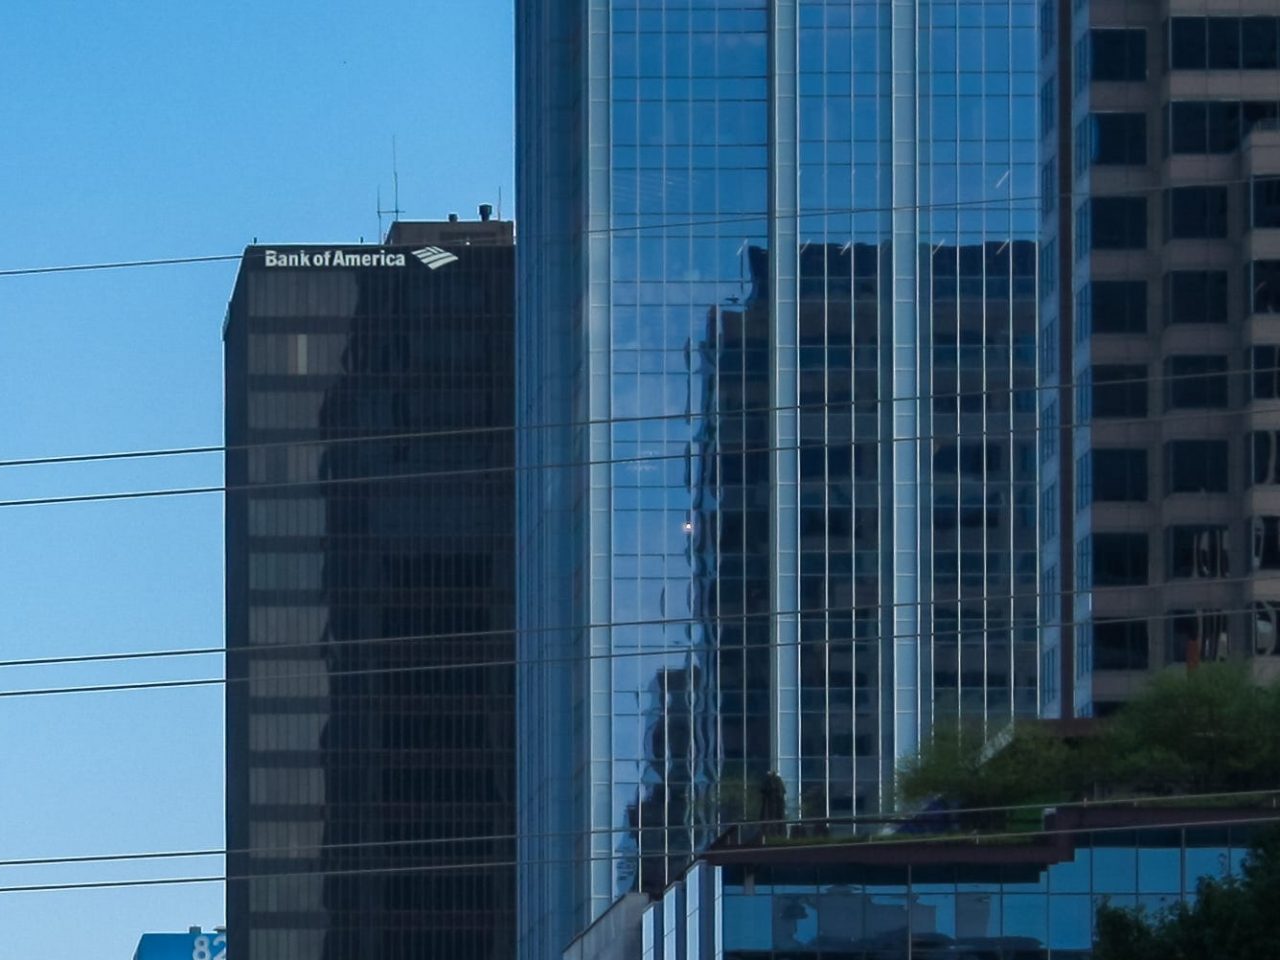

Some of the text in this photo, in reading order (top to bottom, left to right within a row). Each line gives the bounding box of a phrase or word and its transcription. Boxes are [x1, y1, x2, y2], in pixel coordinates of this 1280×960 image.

[265, 250, 406, 267] Bank of America
